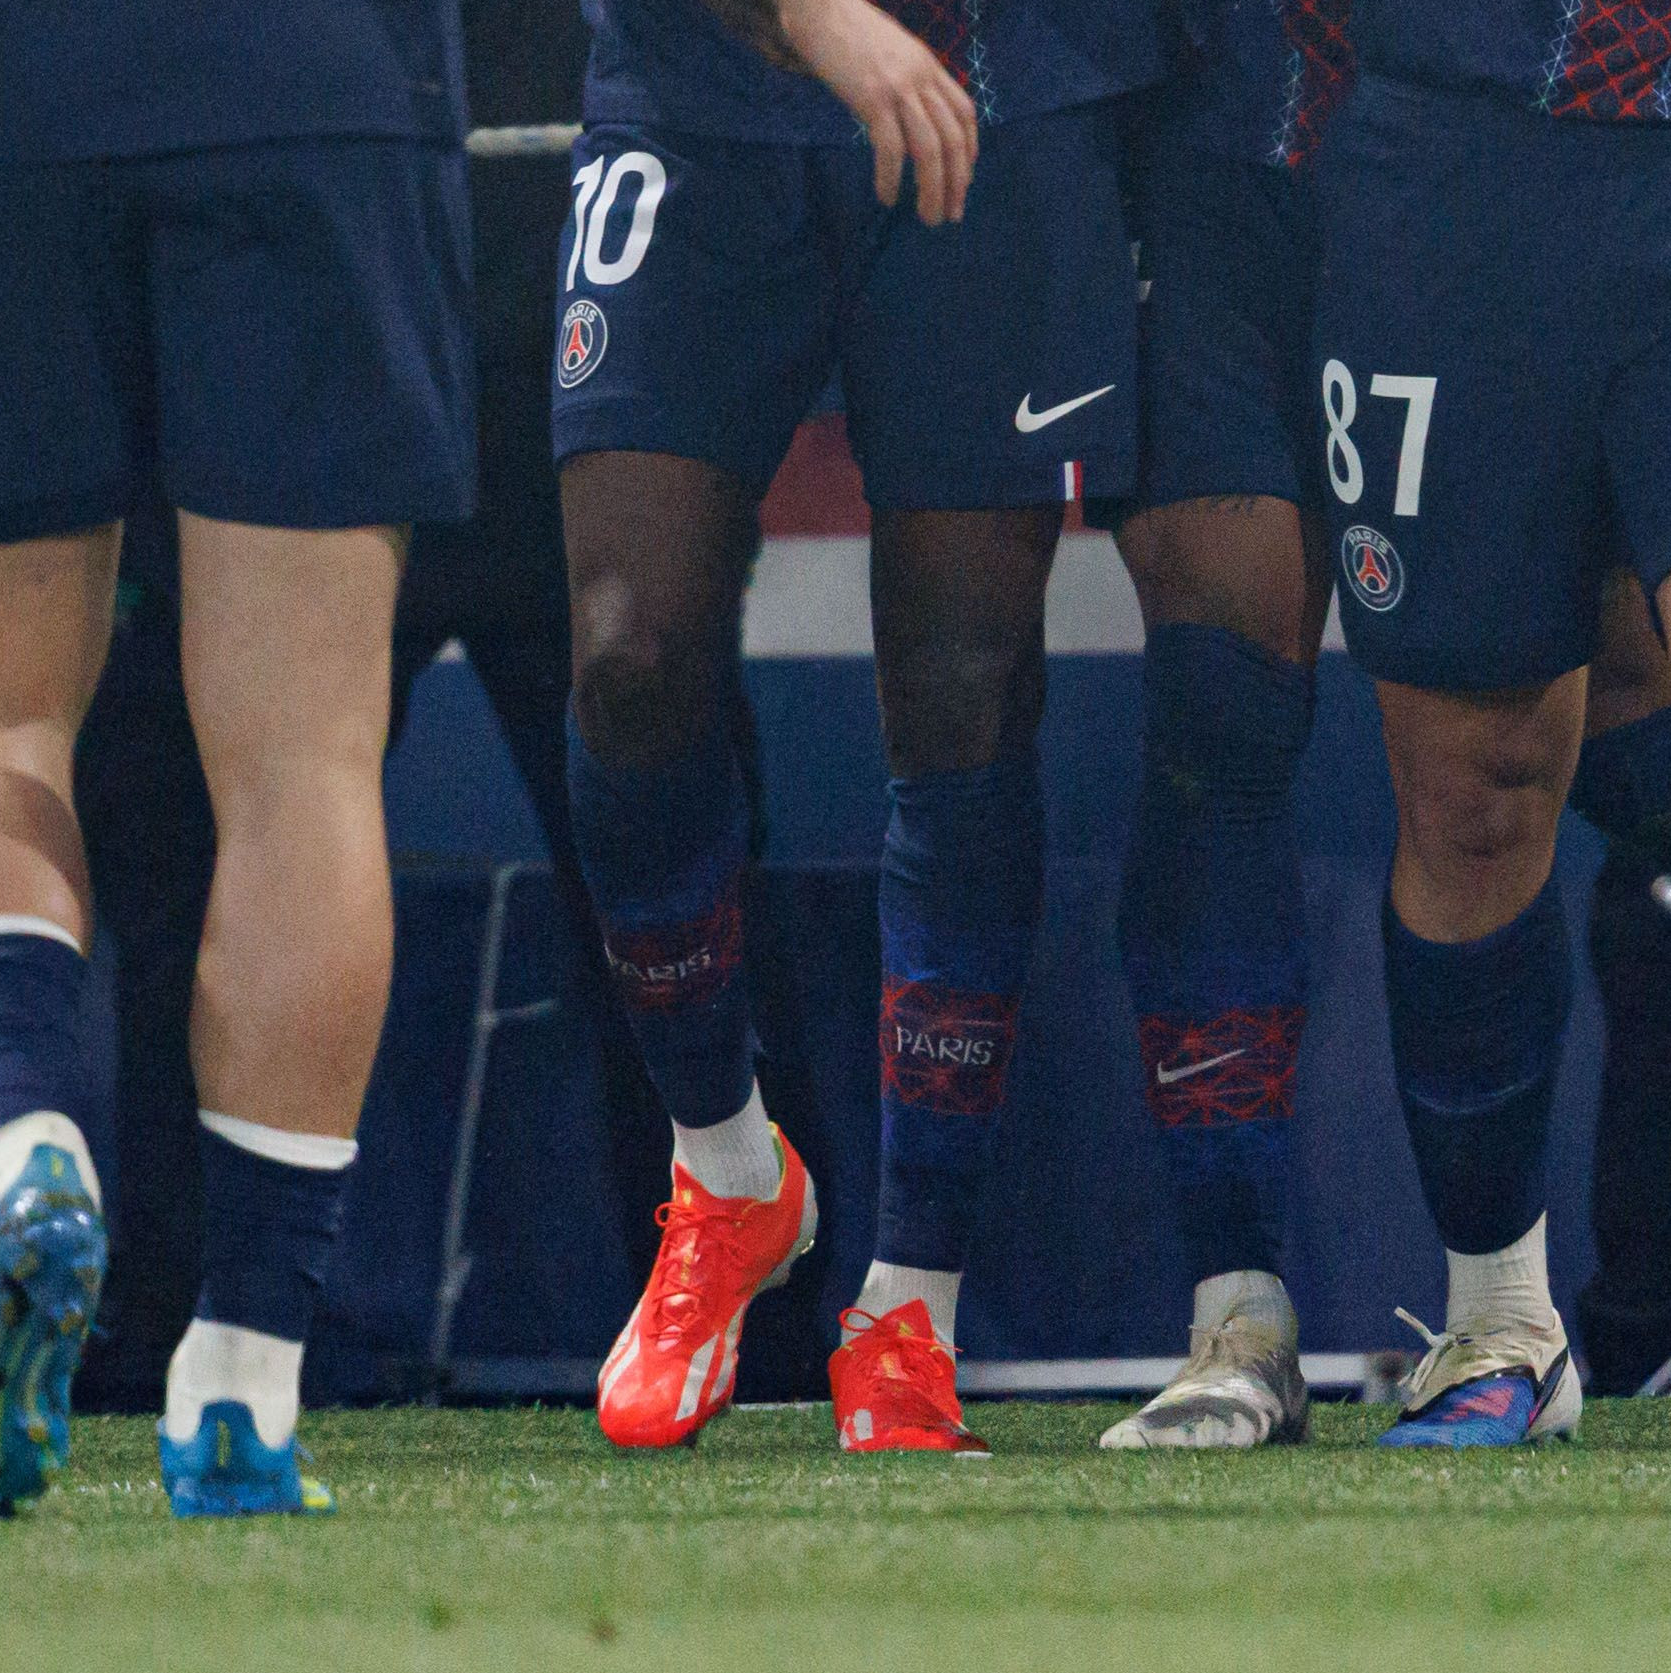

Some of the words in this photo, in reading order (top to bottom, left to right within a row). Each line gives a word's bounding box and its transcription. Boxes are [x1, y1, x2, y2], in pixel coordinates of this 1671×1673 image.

[566, 151, 667, 292] 10
[1322, 359, 1438, 516] 87
[897, 1026, 995, 1065] PARIS
